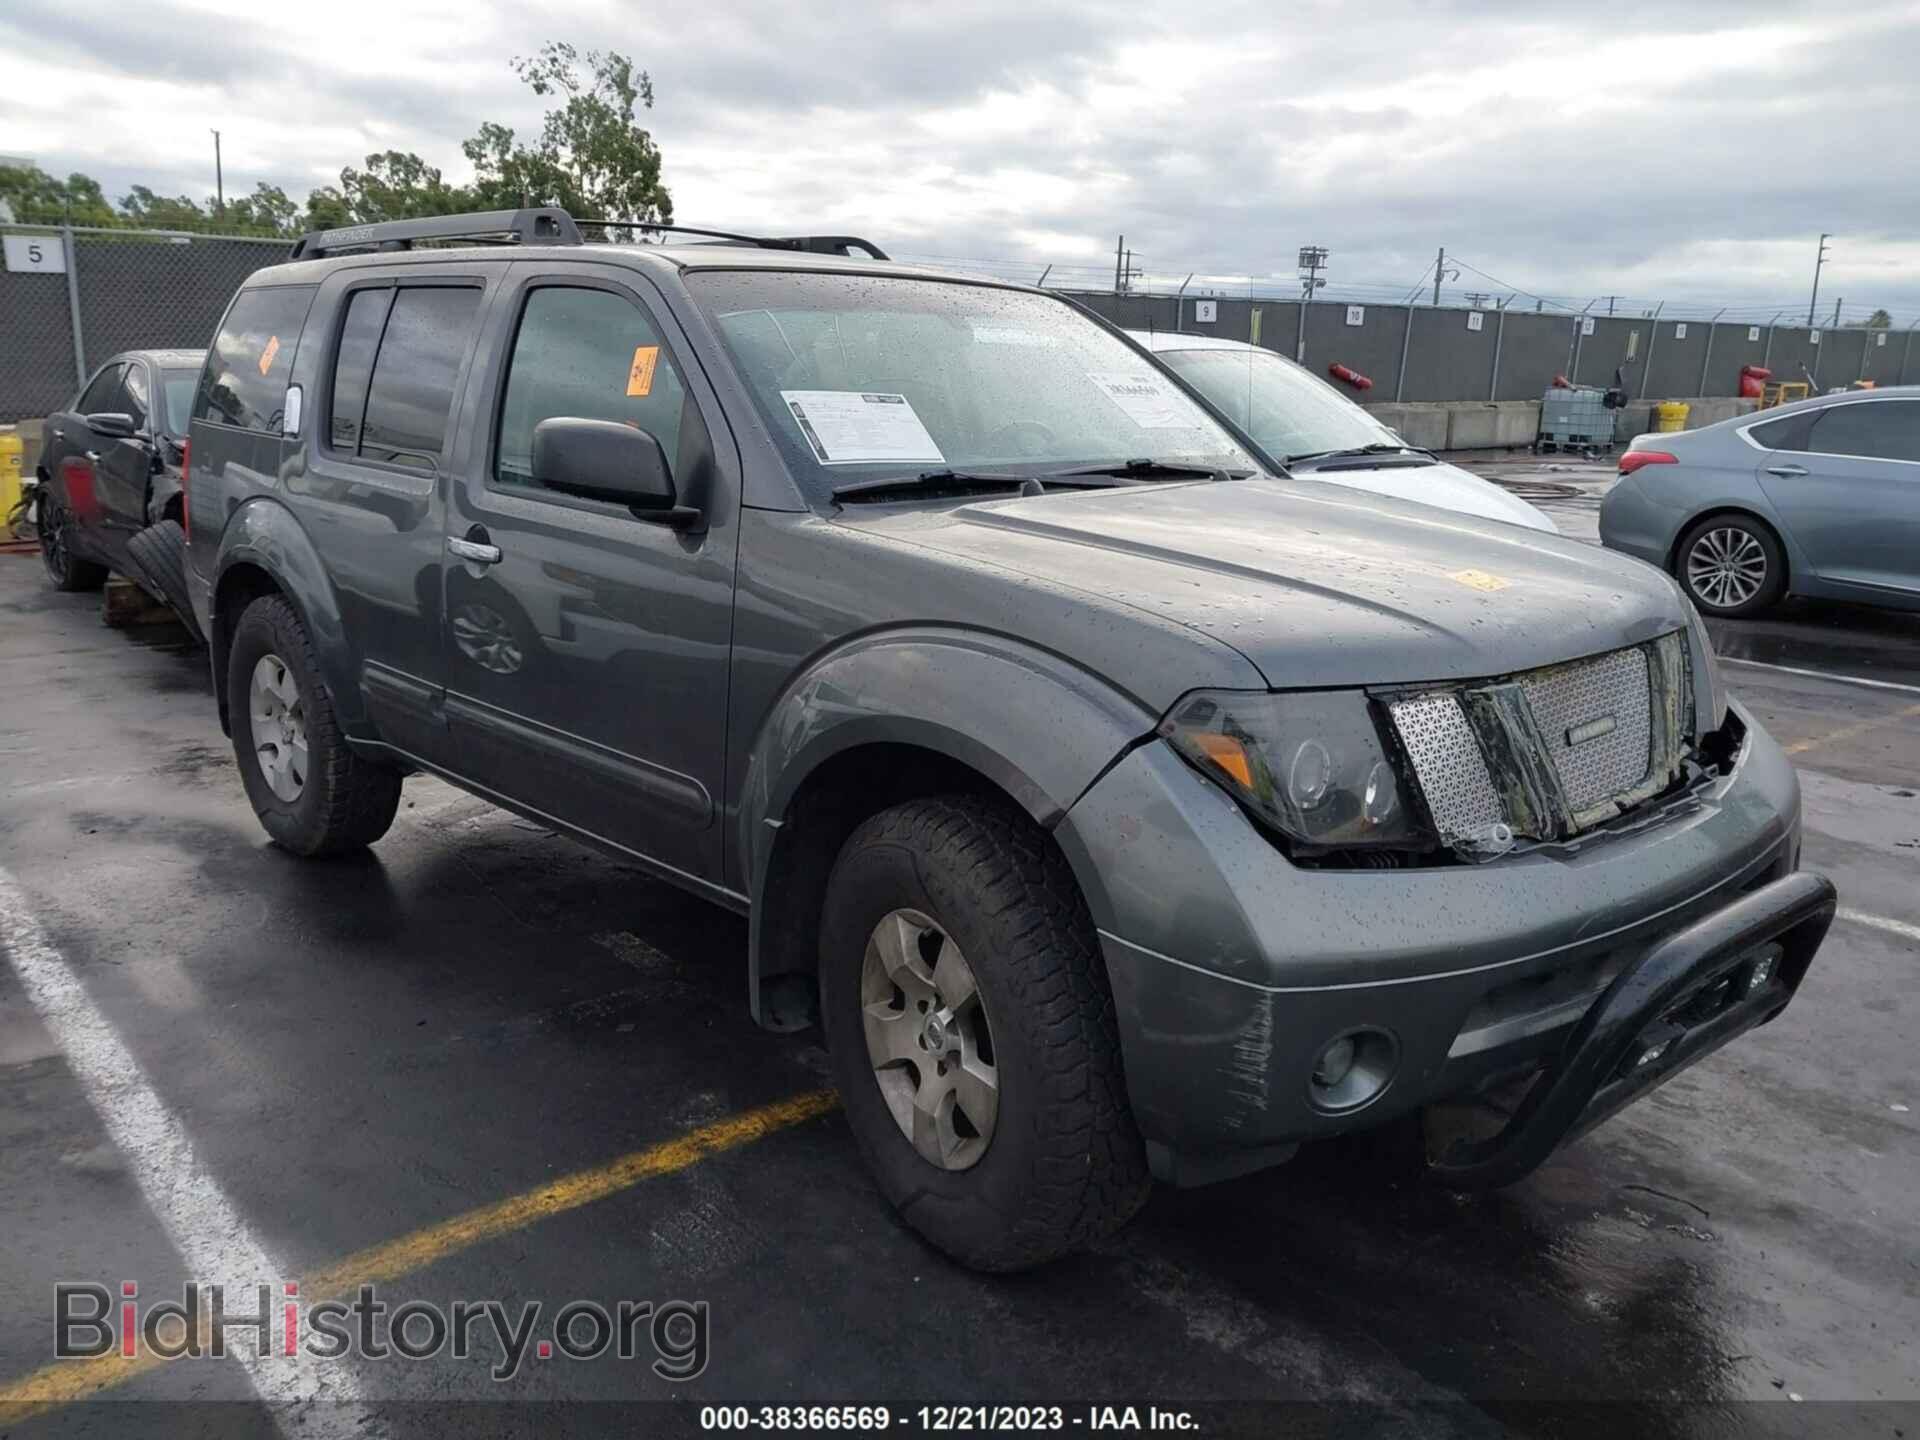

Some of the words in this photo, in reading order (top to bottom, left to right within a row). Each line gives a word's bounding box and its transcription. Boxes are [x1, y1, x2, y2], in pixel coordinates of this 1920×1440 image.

[29, 245, 43, 263] 5
[1202, 305, 1210, 317] 9
[1351, 310, 1361, 321] 10
